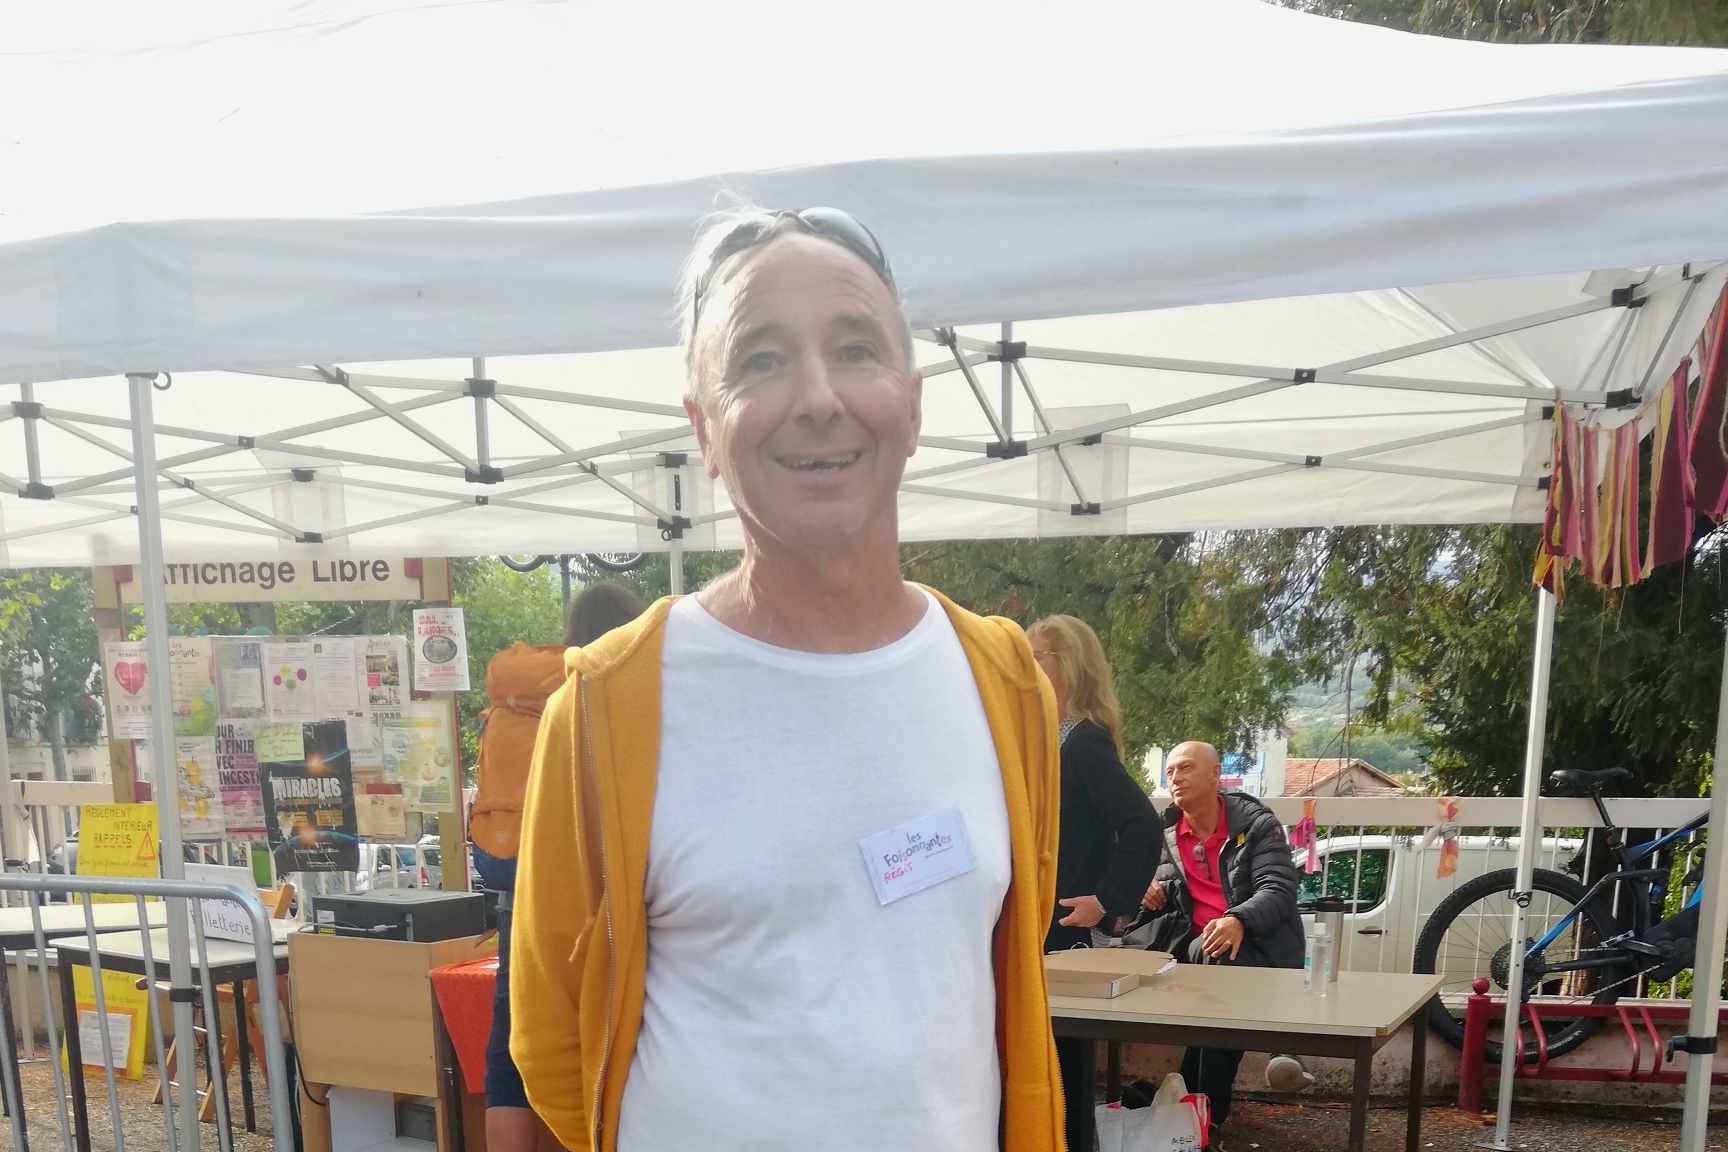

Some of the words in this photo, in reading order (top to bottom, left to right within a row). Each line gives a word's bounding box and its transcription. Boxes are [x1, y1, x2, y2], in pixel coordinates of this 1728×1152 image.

[164, 561, 295, 589] ffichage
[312, 559, 390, 582] Libre
[170, 648, 200, 658] onnantes
[218, 724, 234, 738] OUR
[216, 740, 222, 754] N
[225, 739, 255, 754] FINIR
[217, 756, 235, 769] VEC
[272, 777, 342, 799] MIRACLES
[113, 820, 153, 832] INTÉRIEUR
[906, 832, 921, 844] les
[883, 832, 952, 867] Foisonnantes
[190, 910, 252, 935] lletterie
